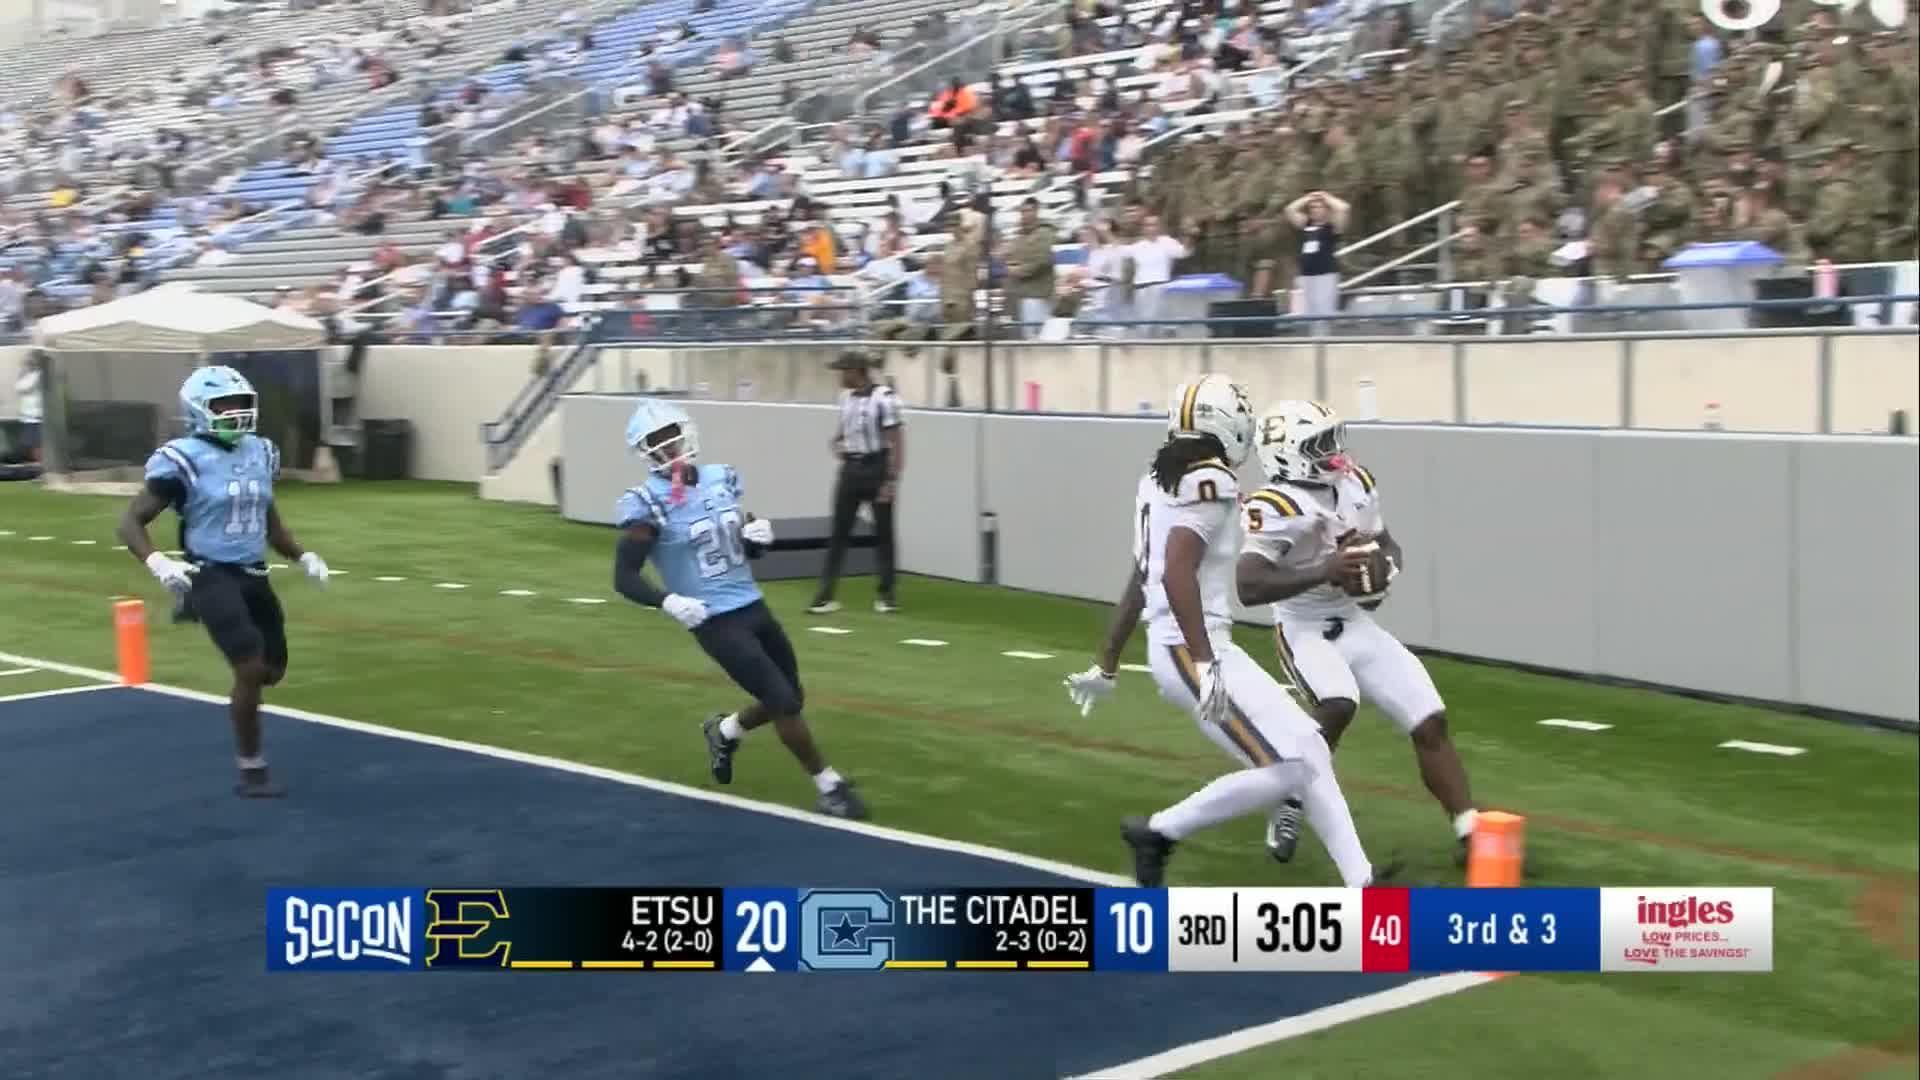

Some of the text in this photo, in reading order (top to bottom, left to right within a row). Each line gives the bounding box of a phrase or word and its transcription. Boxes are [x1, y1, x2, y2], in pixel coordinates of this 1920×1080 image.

[225, 479, 261, 535] 11
[1248, 507, 1264, 531] 5
[689, 508, 745, 577] 20
